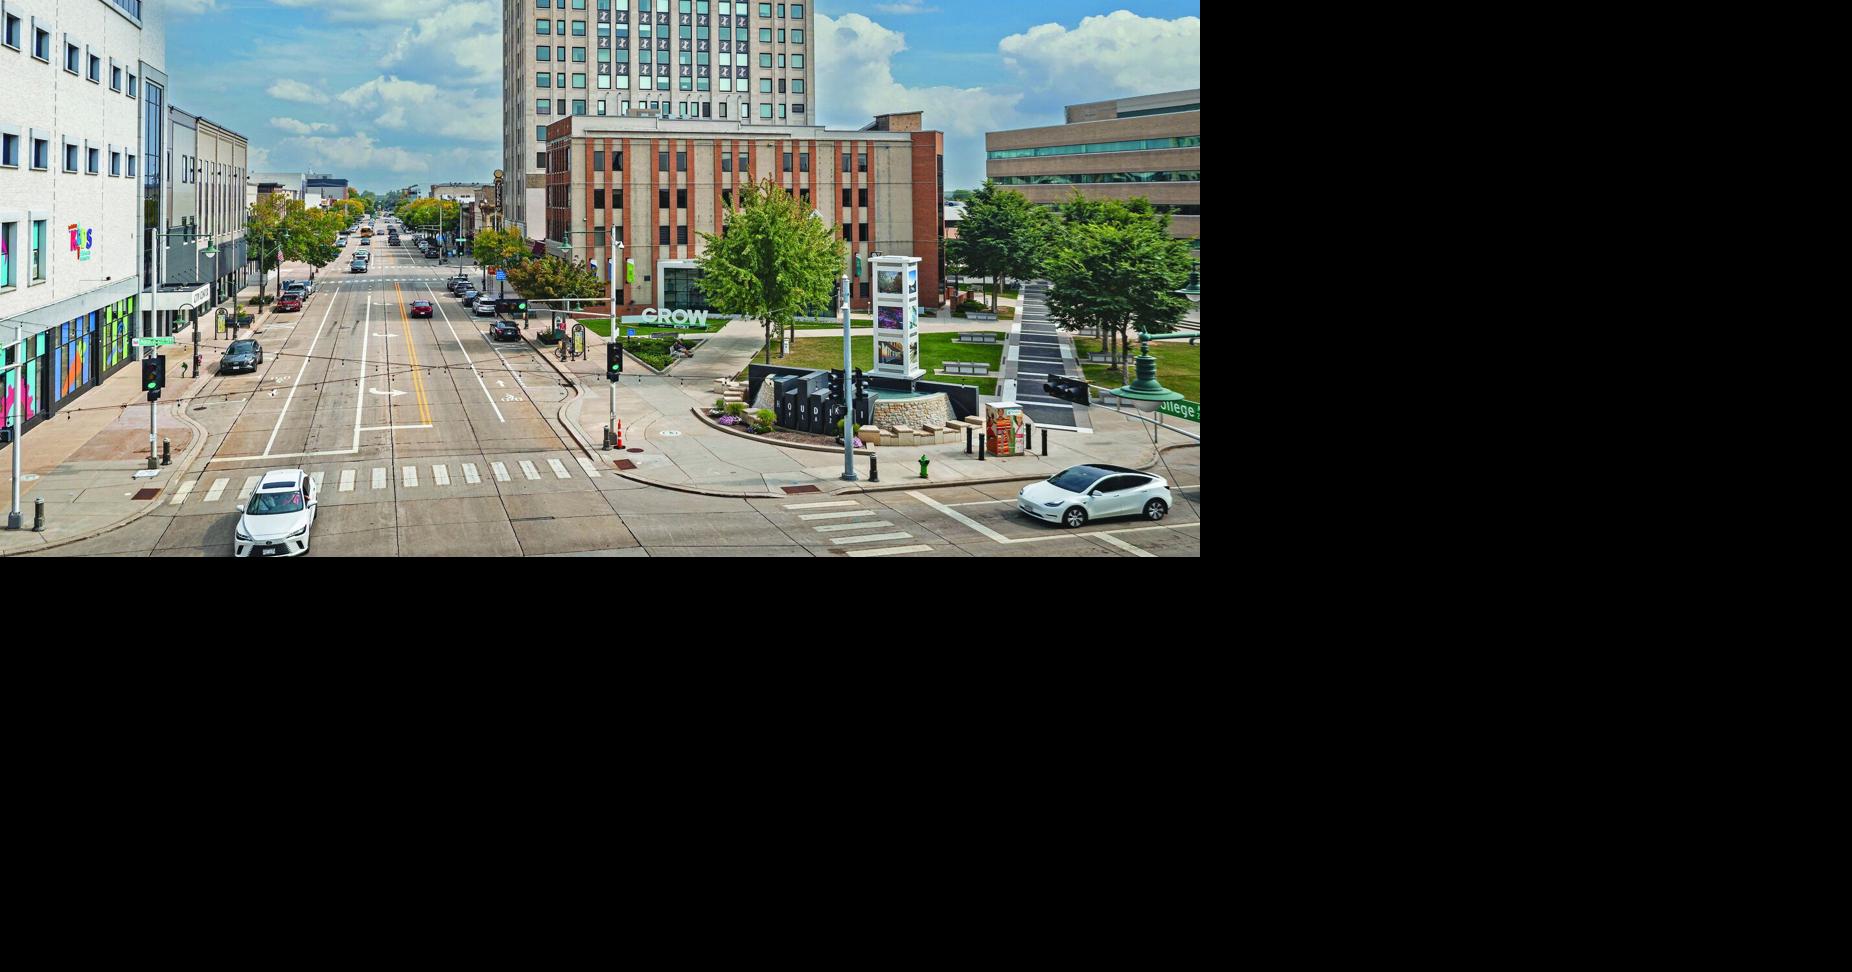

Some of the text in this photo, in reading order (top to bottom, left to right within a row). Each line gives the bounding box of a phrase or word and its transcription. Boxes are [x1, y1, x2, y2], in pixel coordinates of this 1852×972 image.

[642, 308, 709, 327] GROW
[776, 401, 864, 419] HOUDII
[1160, 401, 1194, 418] ollege
